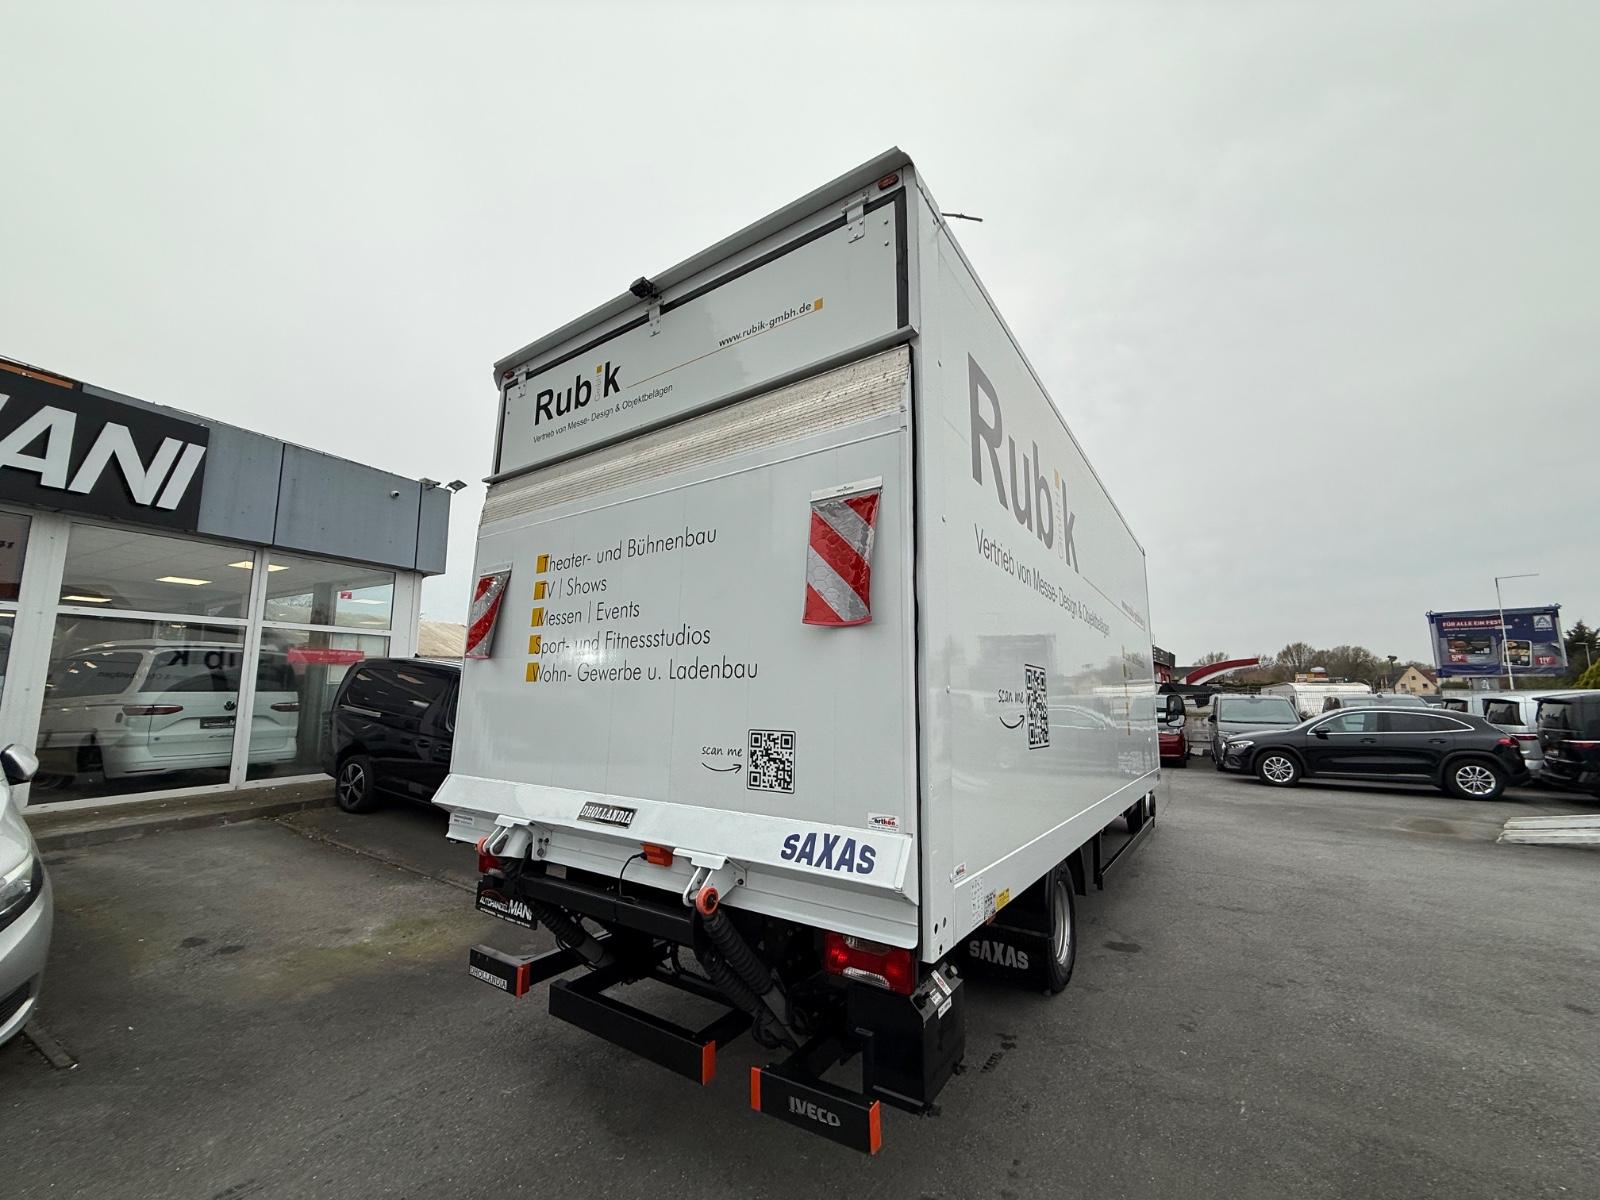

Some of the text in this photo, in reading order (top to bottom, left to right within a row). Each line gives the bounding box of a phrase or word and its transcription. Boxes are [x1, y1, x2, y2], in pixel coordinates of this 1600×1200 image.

[718, 302, 812, 347] www.rubik-gmbh.de
[533, 431, 555, 444] Vertrieb
[555, 427, 567, 436] von
[567, 418, 590, 430] Messe-
[591, 408, 614, 422] Design
[615, 404, 621, 413] &
[0, 393, 207, 511] ANI
[543, 526, 717, 573] Theater- und Bühnenbau
[540, 580, 556, 599] TV
[566, 576, 607, 597] Shows
[974, 523, 1015, 576] Vertrieb
[1016, 561, 1032, 587] von
[1033, 567, 1058, 603] Messe-
[1059, 586, 1077, 619] Design
[537, 609, 582, 627] Messen
[596, 601, 640, 621] Events
[535, 623, 711, 659] Sport- und Fitnessstudios
[532, 655, 758, 683] Wohn- Gewerbe u. Ladenbau
[701, 746, 743, 757] scan me
[580, 805, 634, 824] DHOLLANDIA
[780, 832, 877, 875] SAXAS
[969, 939, 1029, 970] SAXAS
[788, 1095, 841, 1127] IVECO
